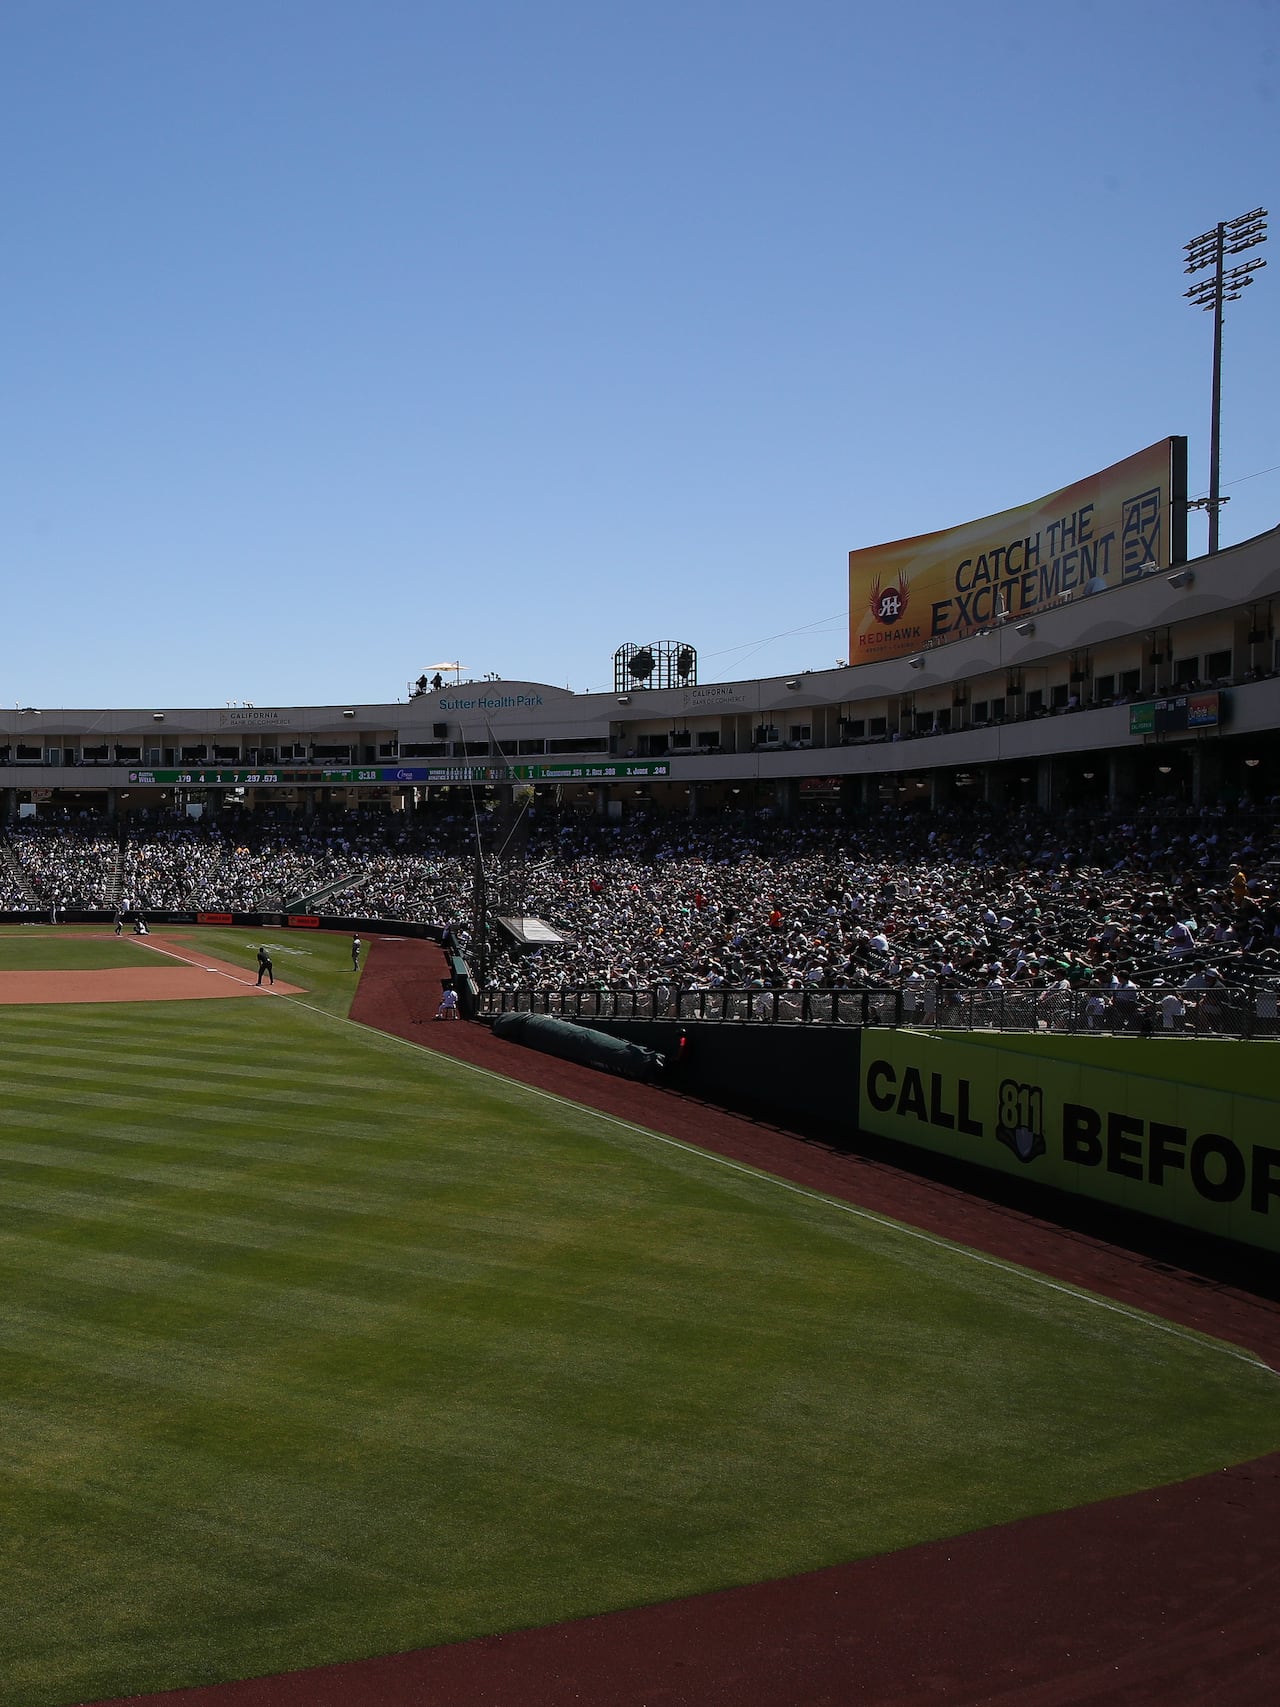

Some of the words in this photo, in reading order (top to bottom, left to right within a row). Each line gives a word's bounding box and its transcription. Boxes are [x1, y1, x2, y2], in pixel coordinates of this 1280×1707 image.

[956, 532, 1040, 593] CATCH
[1047, 504, 1094, 558] THE
[931, 531, 1115, 637] EXCITEMENT
[859, 627, 920, 646] REDHAWK
[439, 698, 477, 710] Sutter
[478, 696, 515, 709] Health
[516, 695, 544, 707] Park
[692, 688, 734, 698] CALIFORNIA
[199, 775, 206, 783] 4
[216, 775, 222, 783] 1
[233, 775, 240, 783] 7
[867, 1060, 983, 1137] CALL
[999, 1078, 1044, 1134] 811
